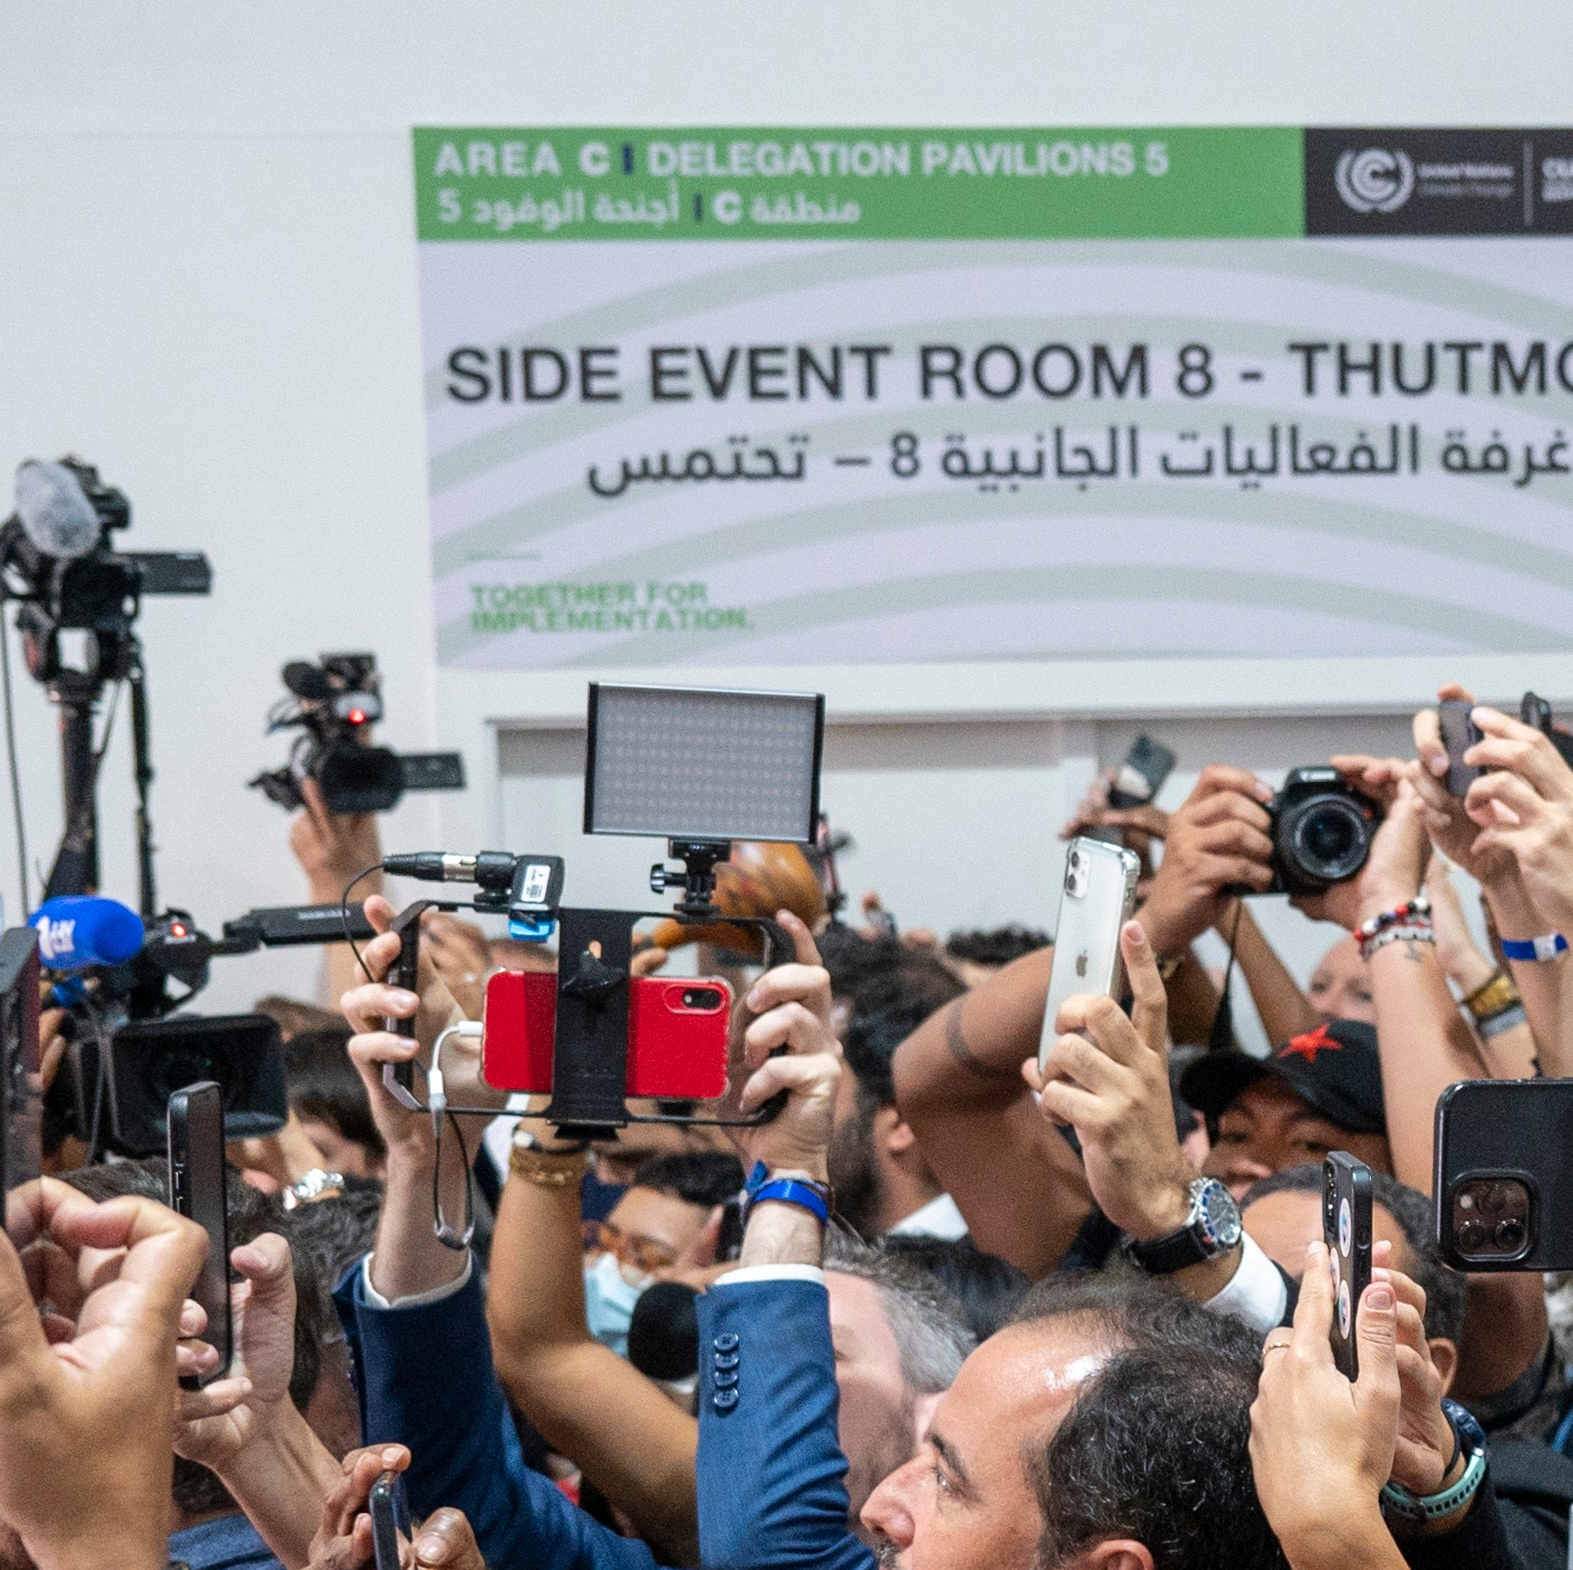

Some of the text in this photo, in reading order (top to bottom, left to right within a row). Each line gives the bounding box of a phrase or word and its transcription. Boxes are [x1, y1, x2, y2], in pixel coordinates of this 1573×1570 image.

[434, 141, 562, 176] AREA
[580, 142, 610, 176] C
[647, 141, 910, 176] DELEGATION
[922, 141, 1136, 176] PAVILIONS
[1145, 142, 1169, 176] 5
[437, 187, 461, 223] 5
[472, 188, 585, 231] الوفود
[713, 190, 742, 223] C
[749, 190, 862, 223] منطقة
[446, 345, 624, 403] SIDE
[650, 345, 892, 401] EVENT
[919, 342, 1149, 400] ROOM
[1177, 342, 1215, 399] 8
[587, 434, 811, 499] تحتمس
[890, 431, 921, 480] 8
[941, 423, 1139, 494] الجانبية
[1159, 423, 1420, 491] الفعاليات
[1441, 427, 1571, 489] غرفة
[471, 580, 708, 606] TOGETHER FOR
